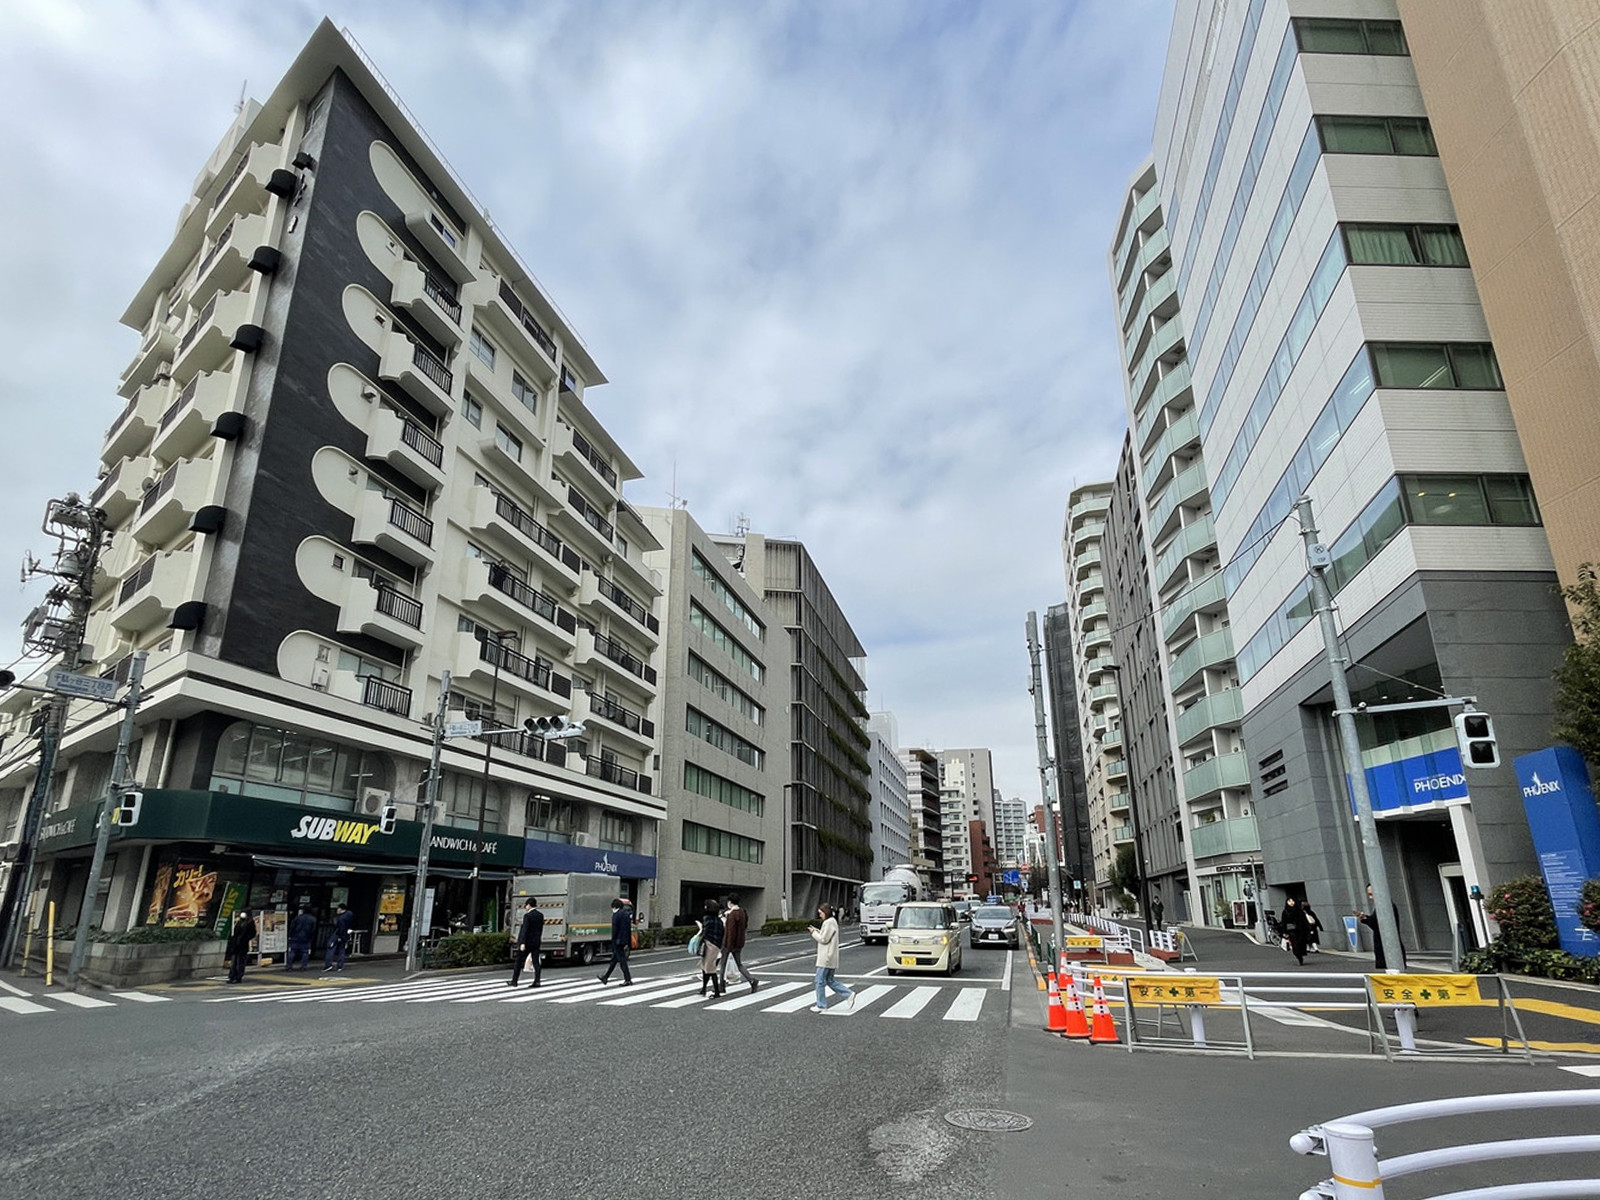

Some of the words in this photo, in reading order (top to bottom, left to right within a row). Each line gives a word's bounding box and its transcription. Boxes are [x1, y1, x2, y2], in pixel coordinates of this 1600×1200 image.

[1413, 773, 1466, 793] PHOENIX
[290, 815, 380, 844] SUBWAY
[430, 836, 472, 851] ANDWICH
[1383, 989, 1413, 1000] 安全
[1437, 989, 1467, 1000] 第一
